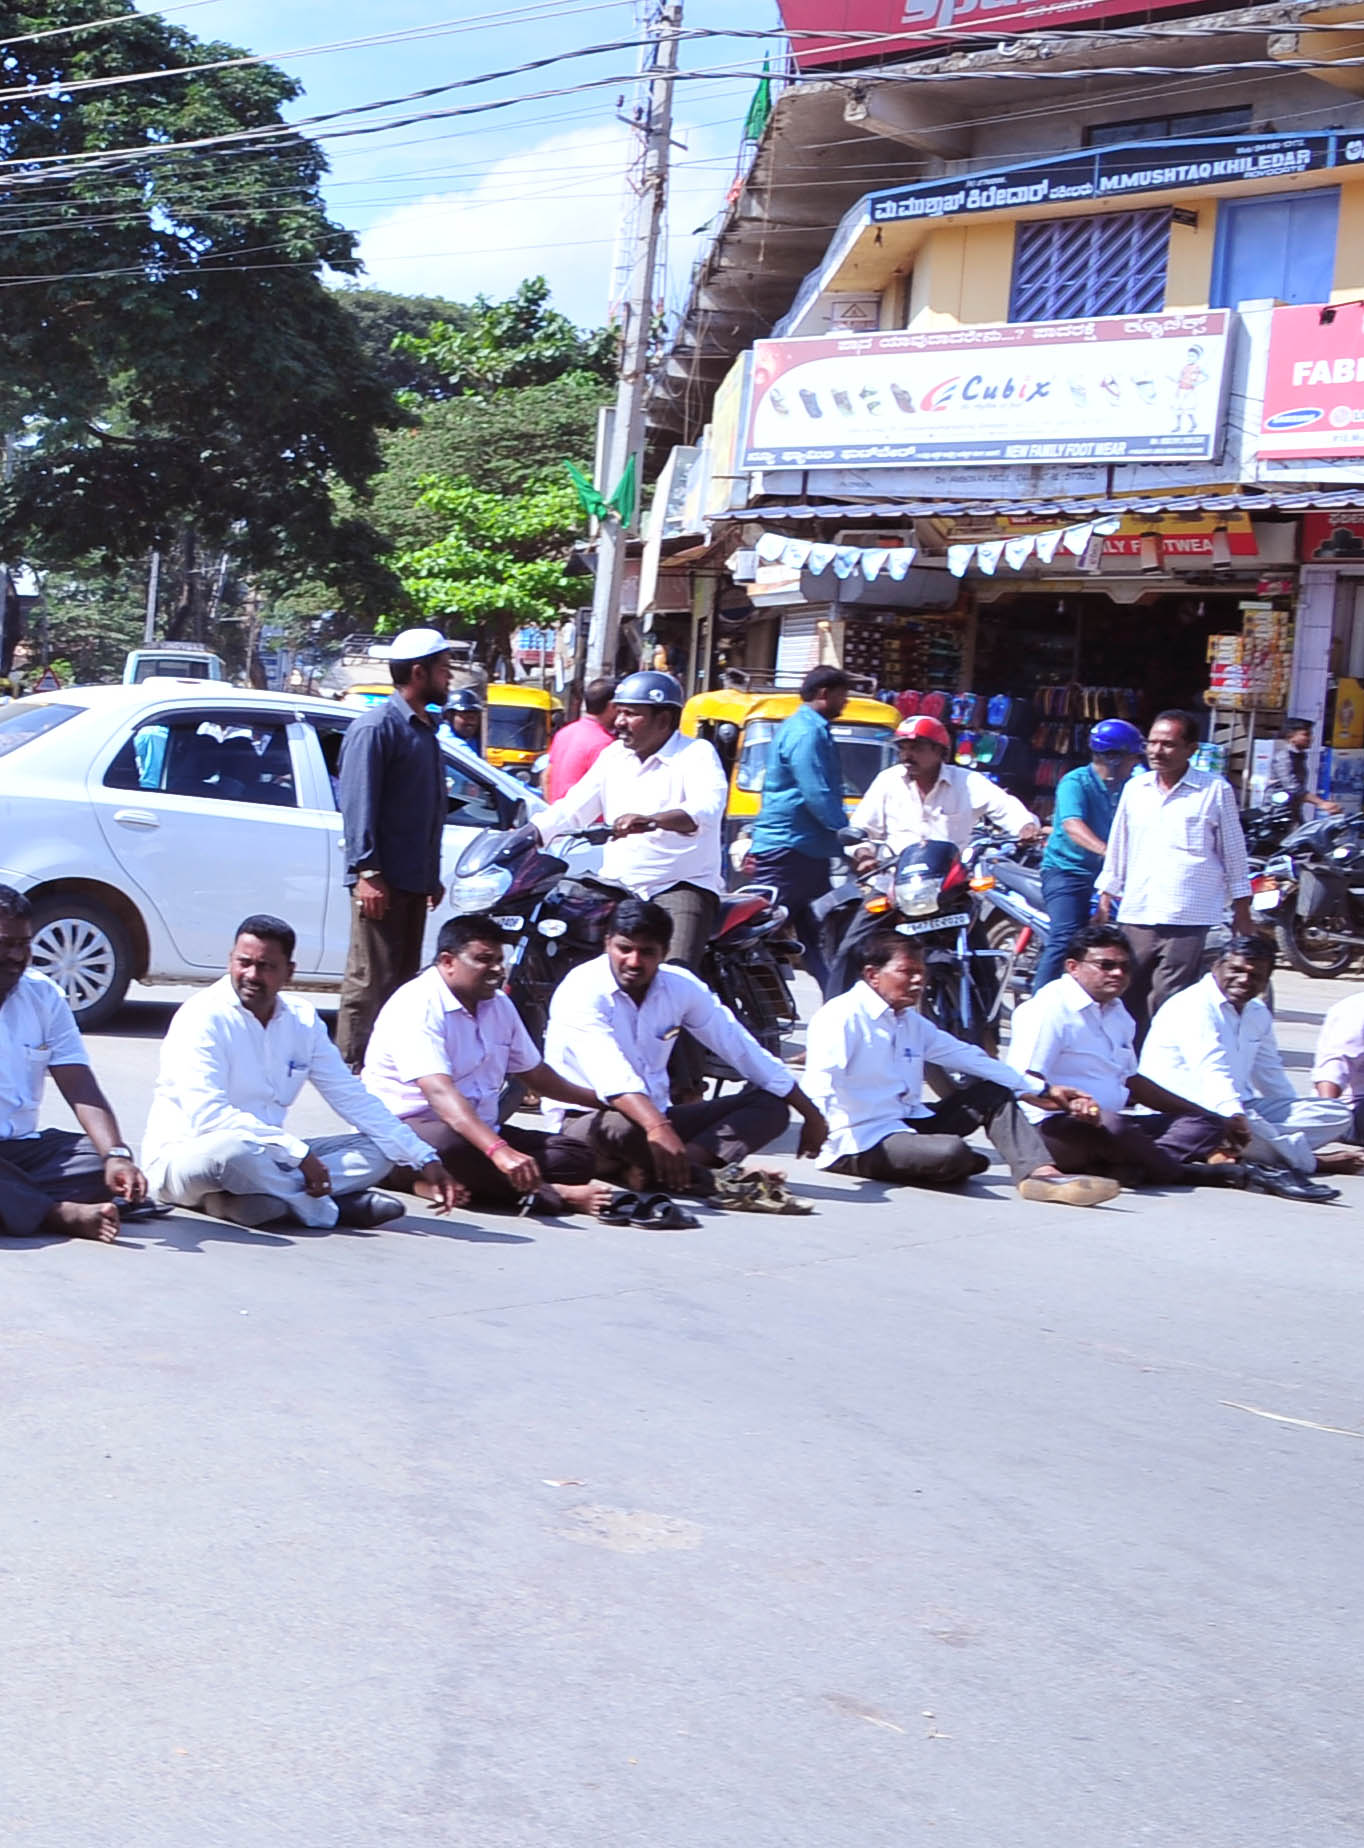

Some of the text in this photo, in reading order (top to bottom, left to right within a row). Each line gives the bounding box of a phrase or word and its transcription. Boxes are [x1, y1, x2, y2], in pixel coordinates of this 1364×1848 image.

[1212, 149, 1311, 176] KHILEDAR
[962, 375, 1051, 402] Cubix
[1004, 444, 1027, 458] NEW
[1026, 443, 1066, 457] FAMILY
[1065, 443, 1094, 457] FOOT
[1095, 441, 1128, 455] WEAR
